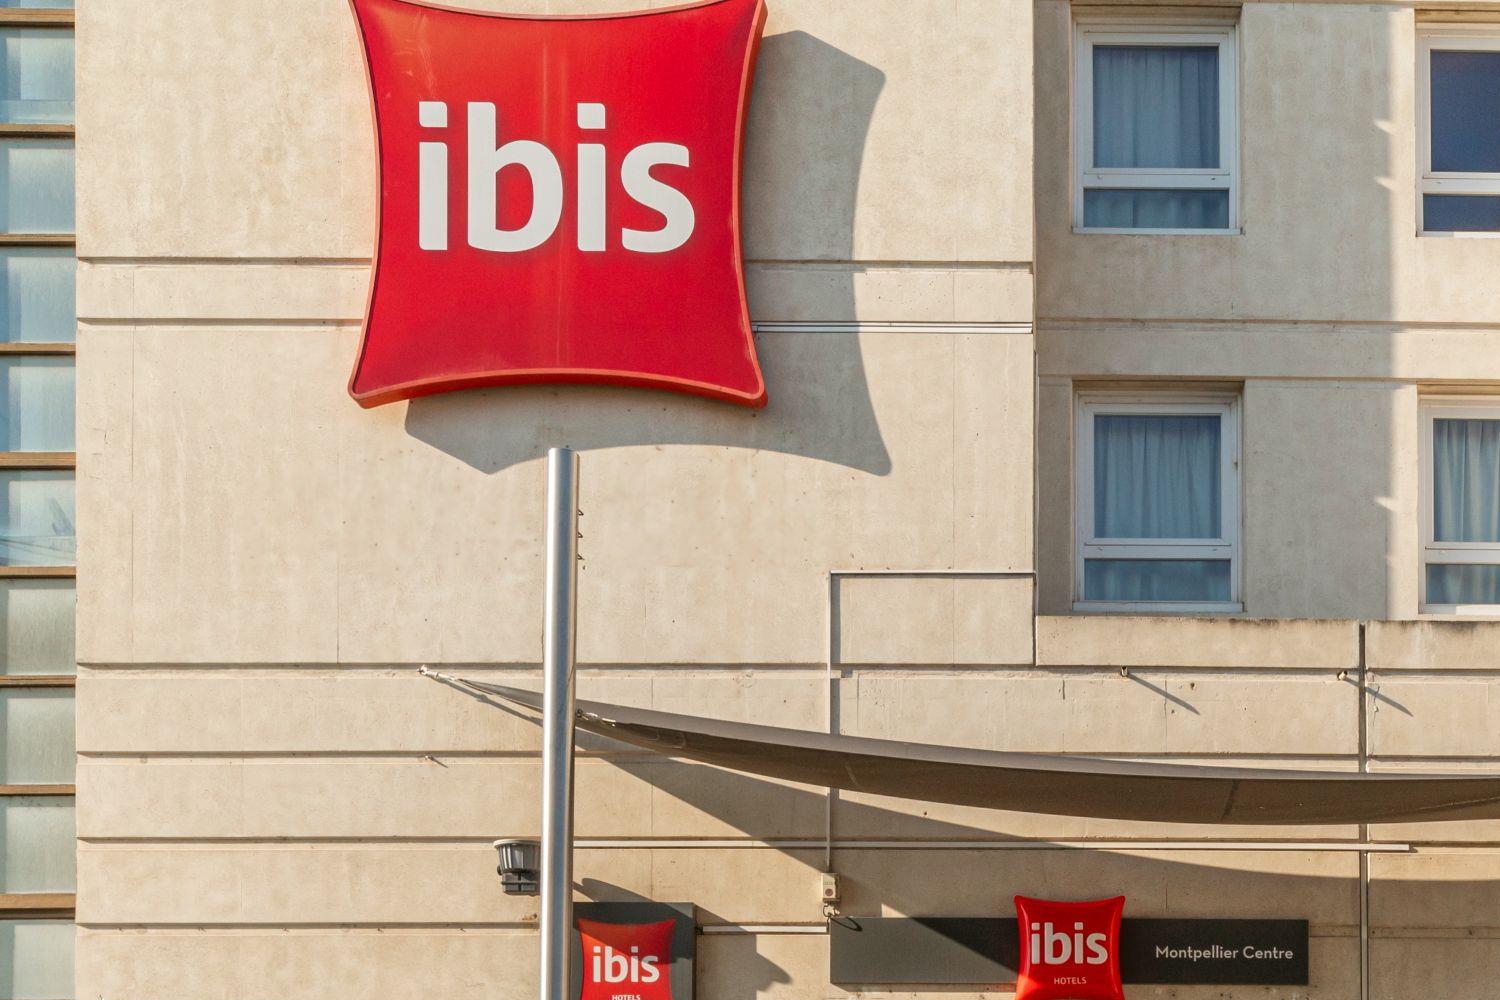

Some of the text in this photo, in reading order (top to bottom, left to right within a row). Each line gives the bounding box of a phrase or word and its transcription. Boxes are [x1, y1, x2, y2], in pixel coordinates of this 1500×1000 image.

[419, 101, 695, 254] ibis
[1031, 921, 1108, 965] ibis
[1155, 945, 1294, 962] Montpellier Centre
[592, 945, 660, 983] ibis
[1053, 976, 1087, 986] HOTELS
